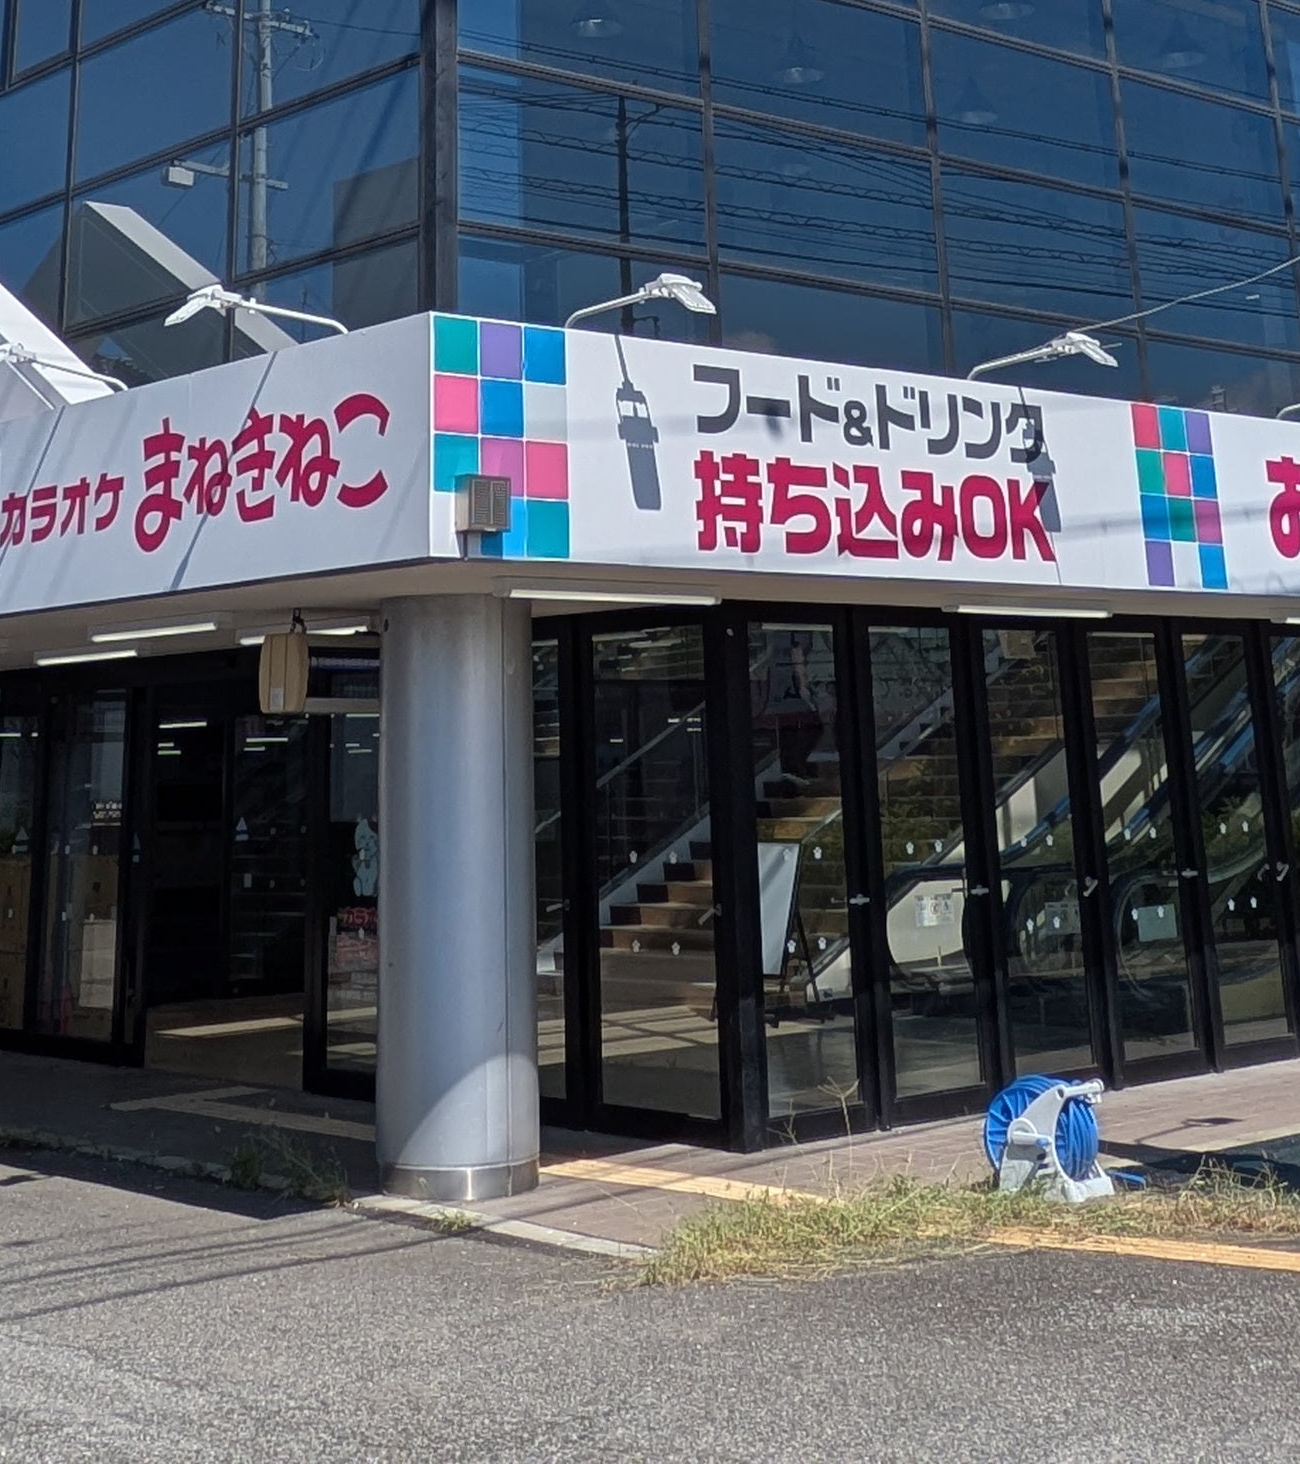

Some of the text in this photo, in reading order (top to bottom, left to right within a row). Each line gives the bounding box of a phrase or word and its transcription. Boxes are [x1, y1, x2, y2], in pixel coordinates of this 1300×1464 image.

[693, 364, 1044, 465] フード&ドリンク
[0, 393, 390, 553] カラオケ まねきねこ
[694, 450, 1057, 562] 持ち込みOK
